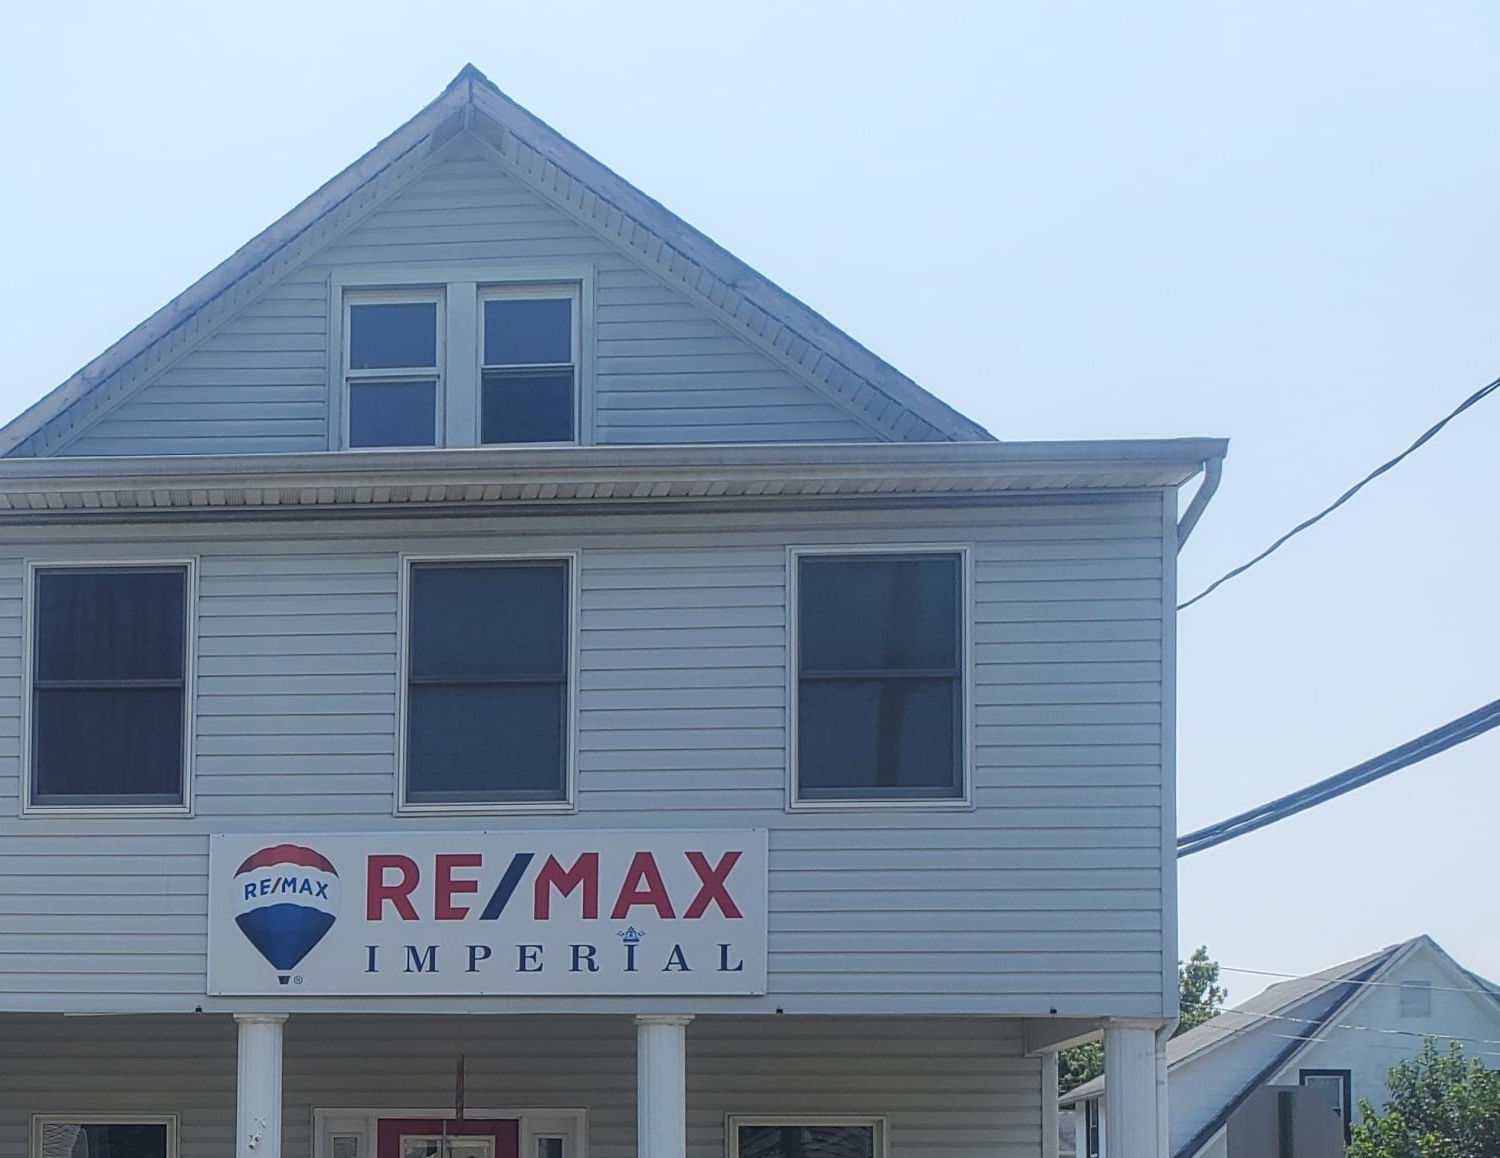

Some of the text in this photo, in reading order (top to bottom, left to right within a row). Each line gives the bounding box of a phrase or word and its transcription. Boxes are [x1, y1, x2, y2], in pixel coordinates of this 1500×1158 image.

[244, 876, 329, 901] RE/MAX
[366, 851, 743, 921] RE/MAX
[364, 944, 744, 973] IMPERIAL
